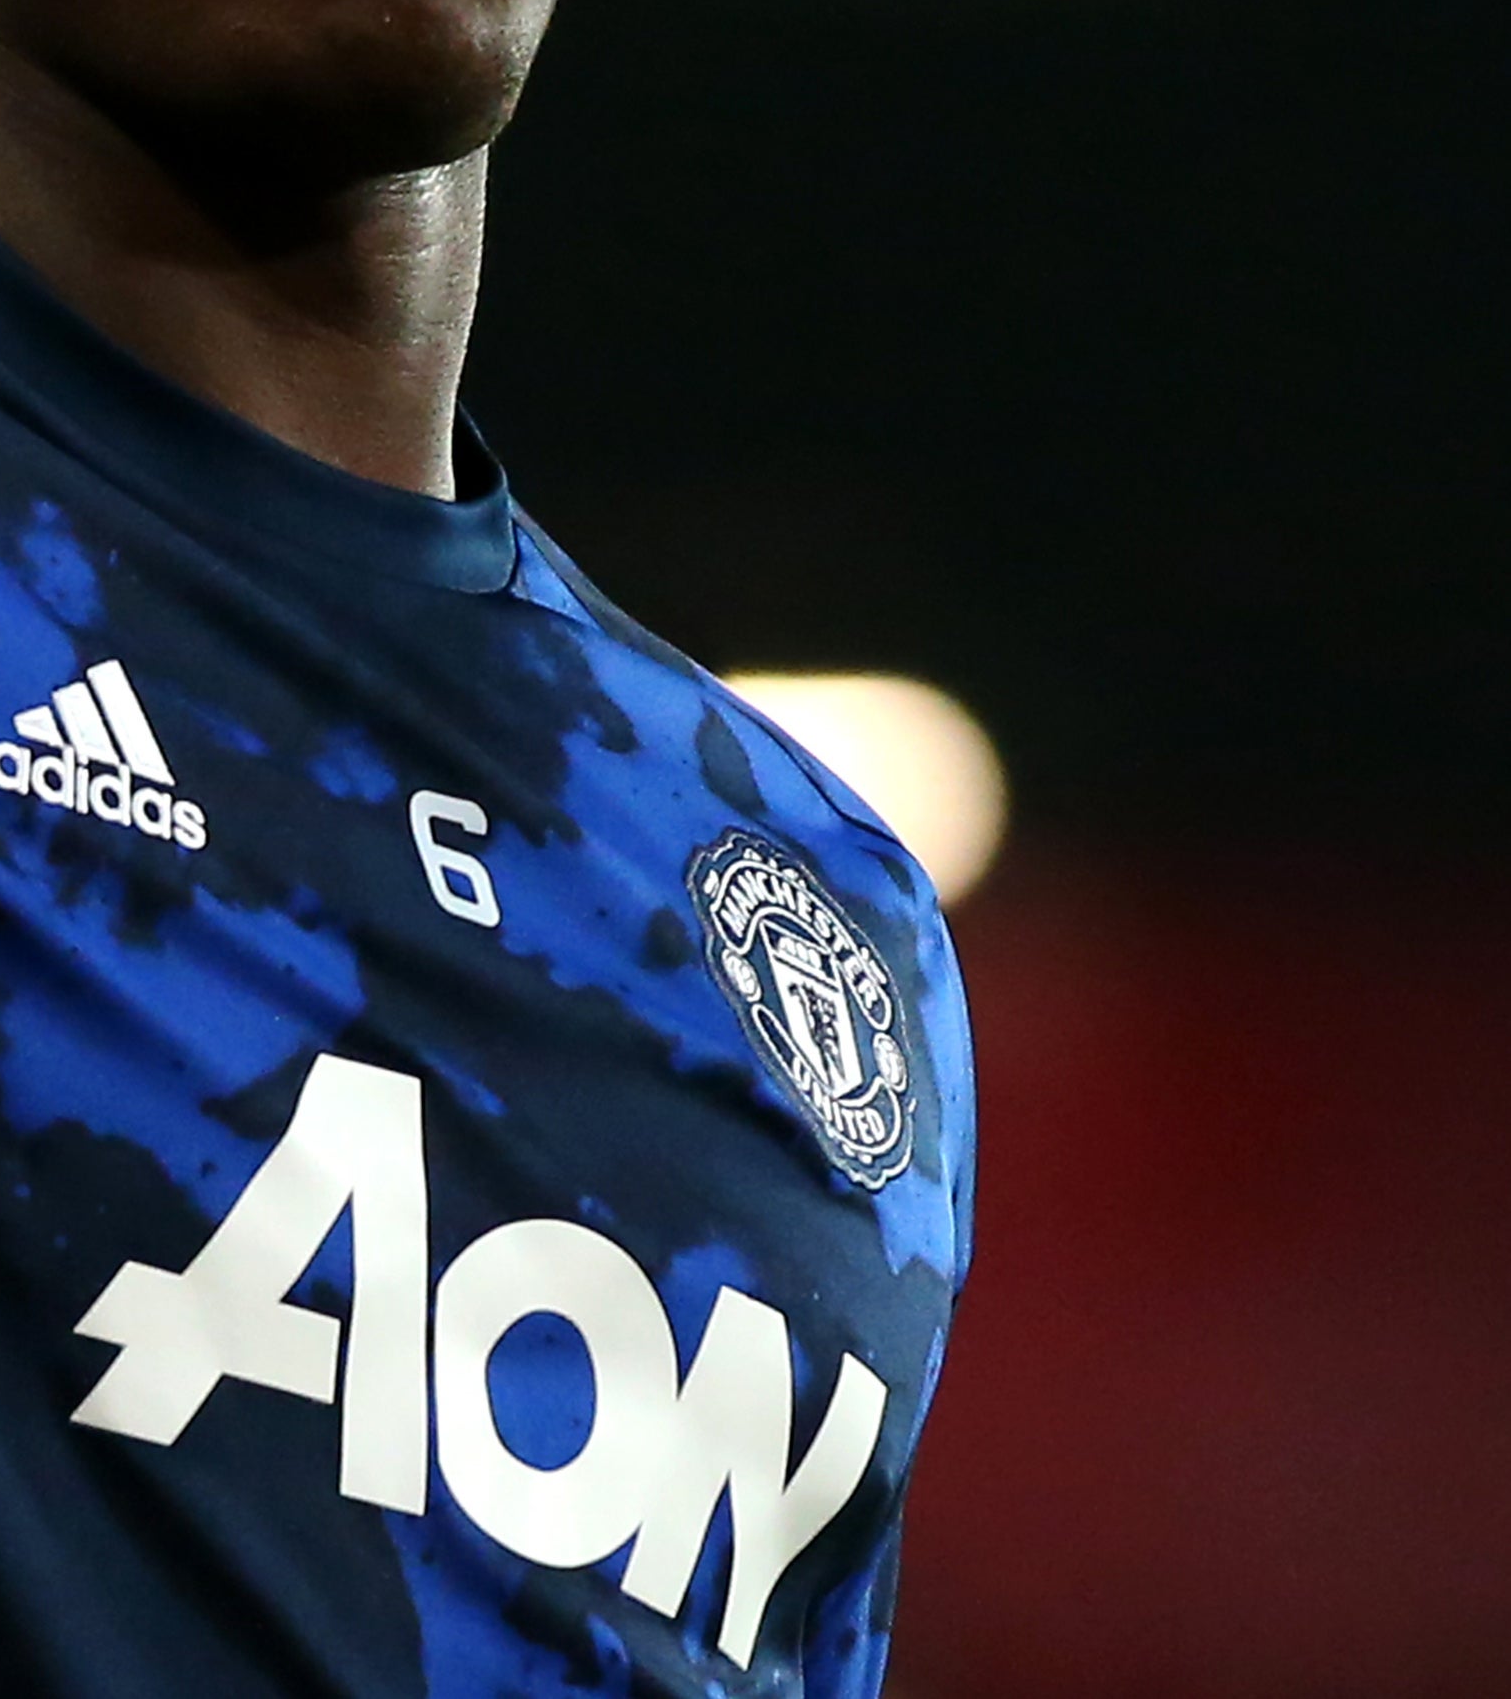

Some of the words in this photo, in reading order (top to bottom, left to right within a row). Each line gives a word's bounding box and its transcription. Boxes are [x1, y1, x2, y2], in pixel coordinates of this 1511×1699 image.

[410, 790, 501, 927] 6
[720, 871, 879, 1008] MANCHESTER
[793, 1057, 885, 1143] UNITED
[70, 1053, 888, 1670] AON
